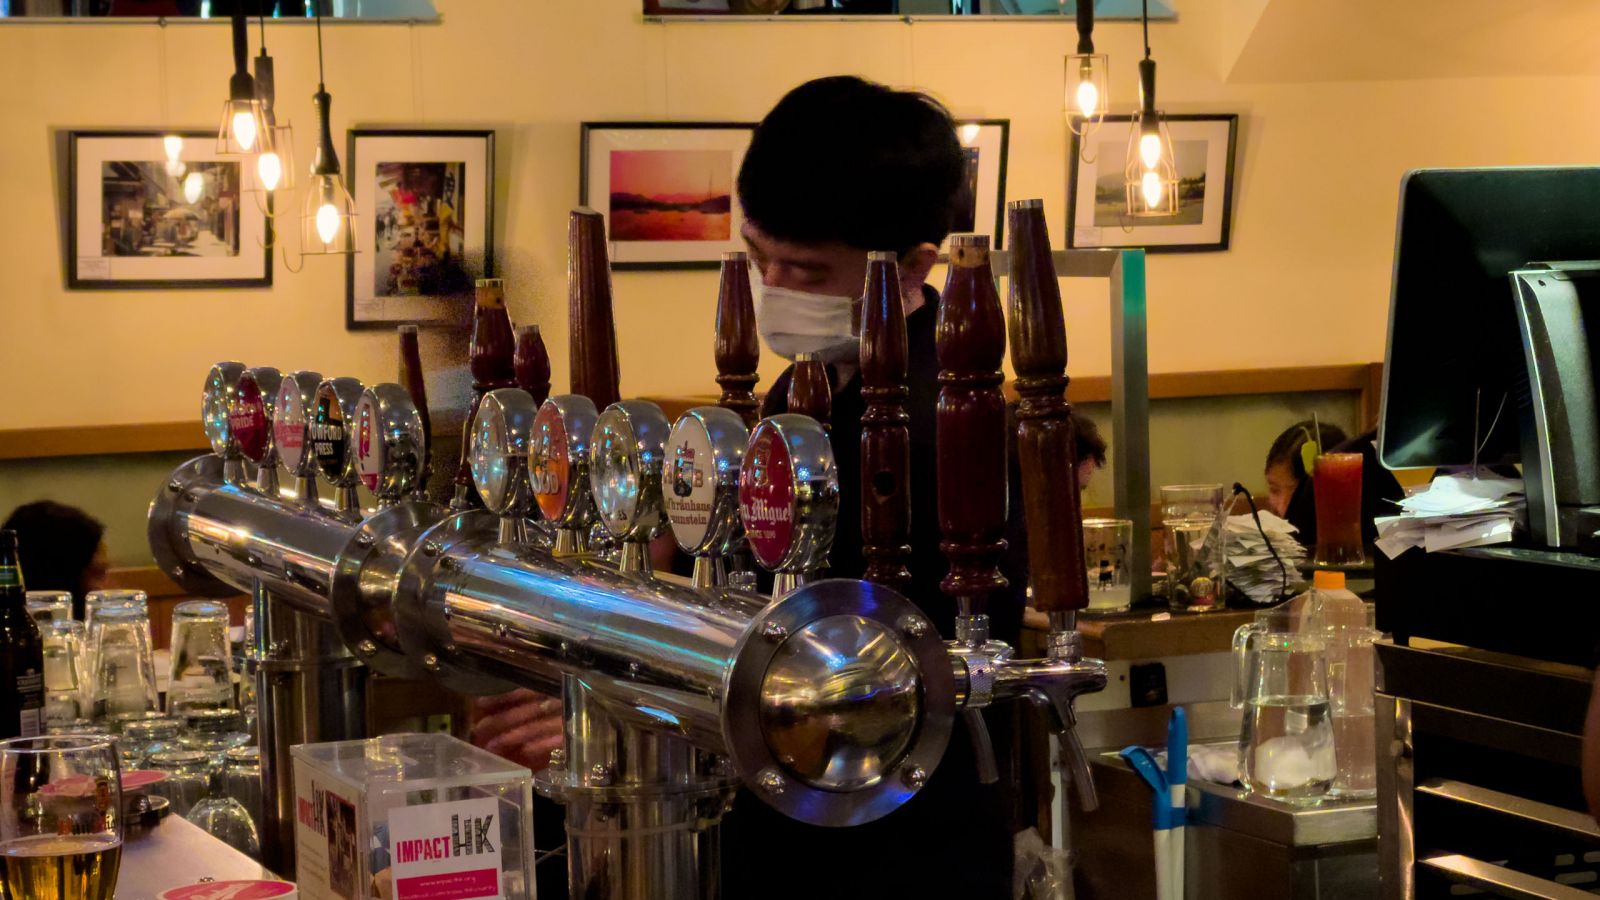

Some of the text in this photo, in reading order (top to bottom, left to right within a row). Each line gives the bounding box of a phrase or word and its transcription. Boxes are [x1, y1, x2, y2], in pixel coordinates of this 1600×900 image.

[314, 442, 334, 456] PRESS
[751, 497, 793, 526] Miguel
[396, 836, 450, 863] IMPACT
